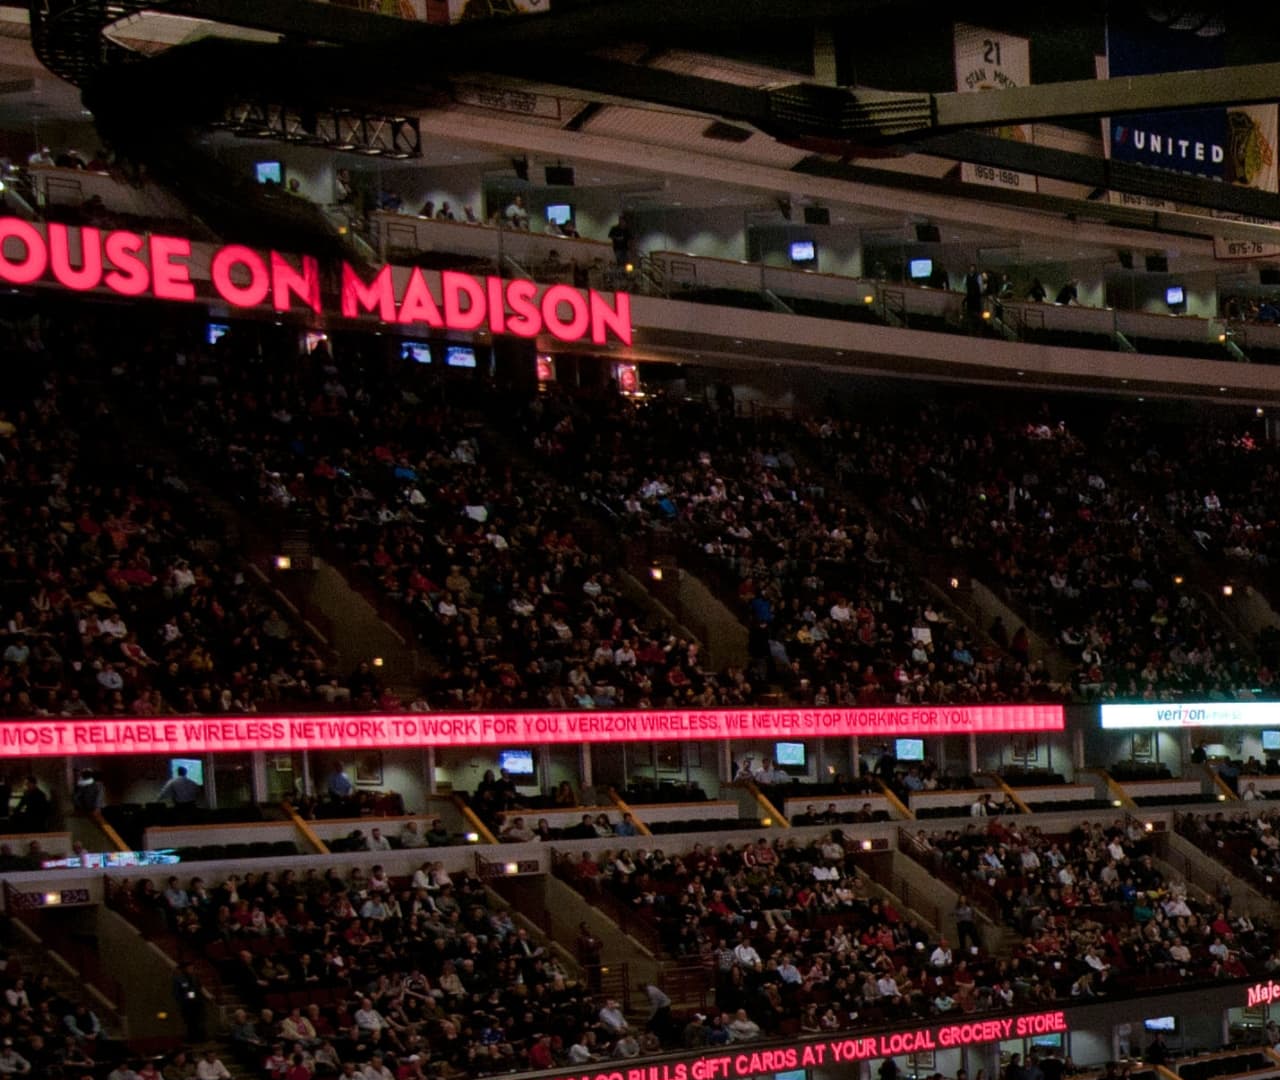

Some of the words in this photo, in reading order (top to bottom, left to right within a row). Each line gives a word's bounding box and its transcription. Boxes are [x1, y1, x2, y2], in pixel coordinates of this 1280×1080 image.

[983, 39, 1001, 66] 21
[1133, 129, 1225, 163] UNITED
[211, 243, 321, 314] ON
[341, 262, 633, 348] MADISON
[4, 725, 68, 745] MOST
[75, 724, 179, 744] RELIABLE
[181, 722, 285, 742] WIRELESS
[289, 721, 388, 740] NETWORK
[390, 721, 418, 736] TO
[420, 719, 477, 736] WORK
[482, 719, 517, 735] FOR
[521, 718, 562, 734] YOU.
[566, 716, 637, 733] VERIZON
[724, 714, 748, 729] WE
[752, 713, 800, 729] NEVER
[803, 712, 841, 727] STOP
[845, 711, 909, 727] WORKING
[912, 710, 938, 726] FOR
[942, 710, 972, 725] YOU.
[1156, 706, 1206, 726] verizon
[735, 1049, 798, 1076] CARDS
[802, 1043, 826, 1066] AT
[830, 1037, 877, 1062] YOUR
[880, 1030, 936, 1054] LOCAL
[939, 1018, 1013, 1046] GROCERY
[1016, 1010, 1068, 1036] STORE.
